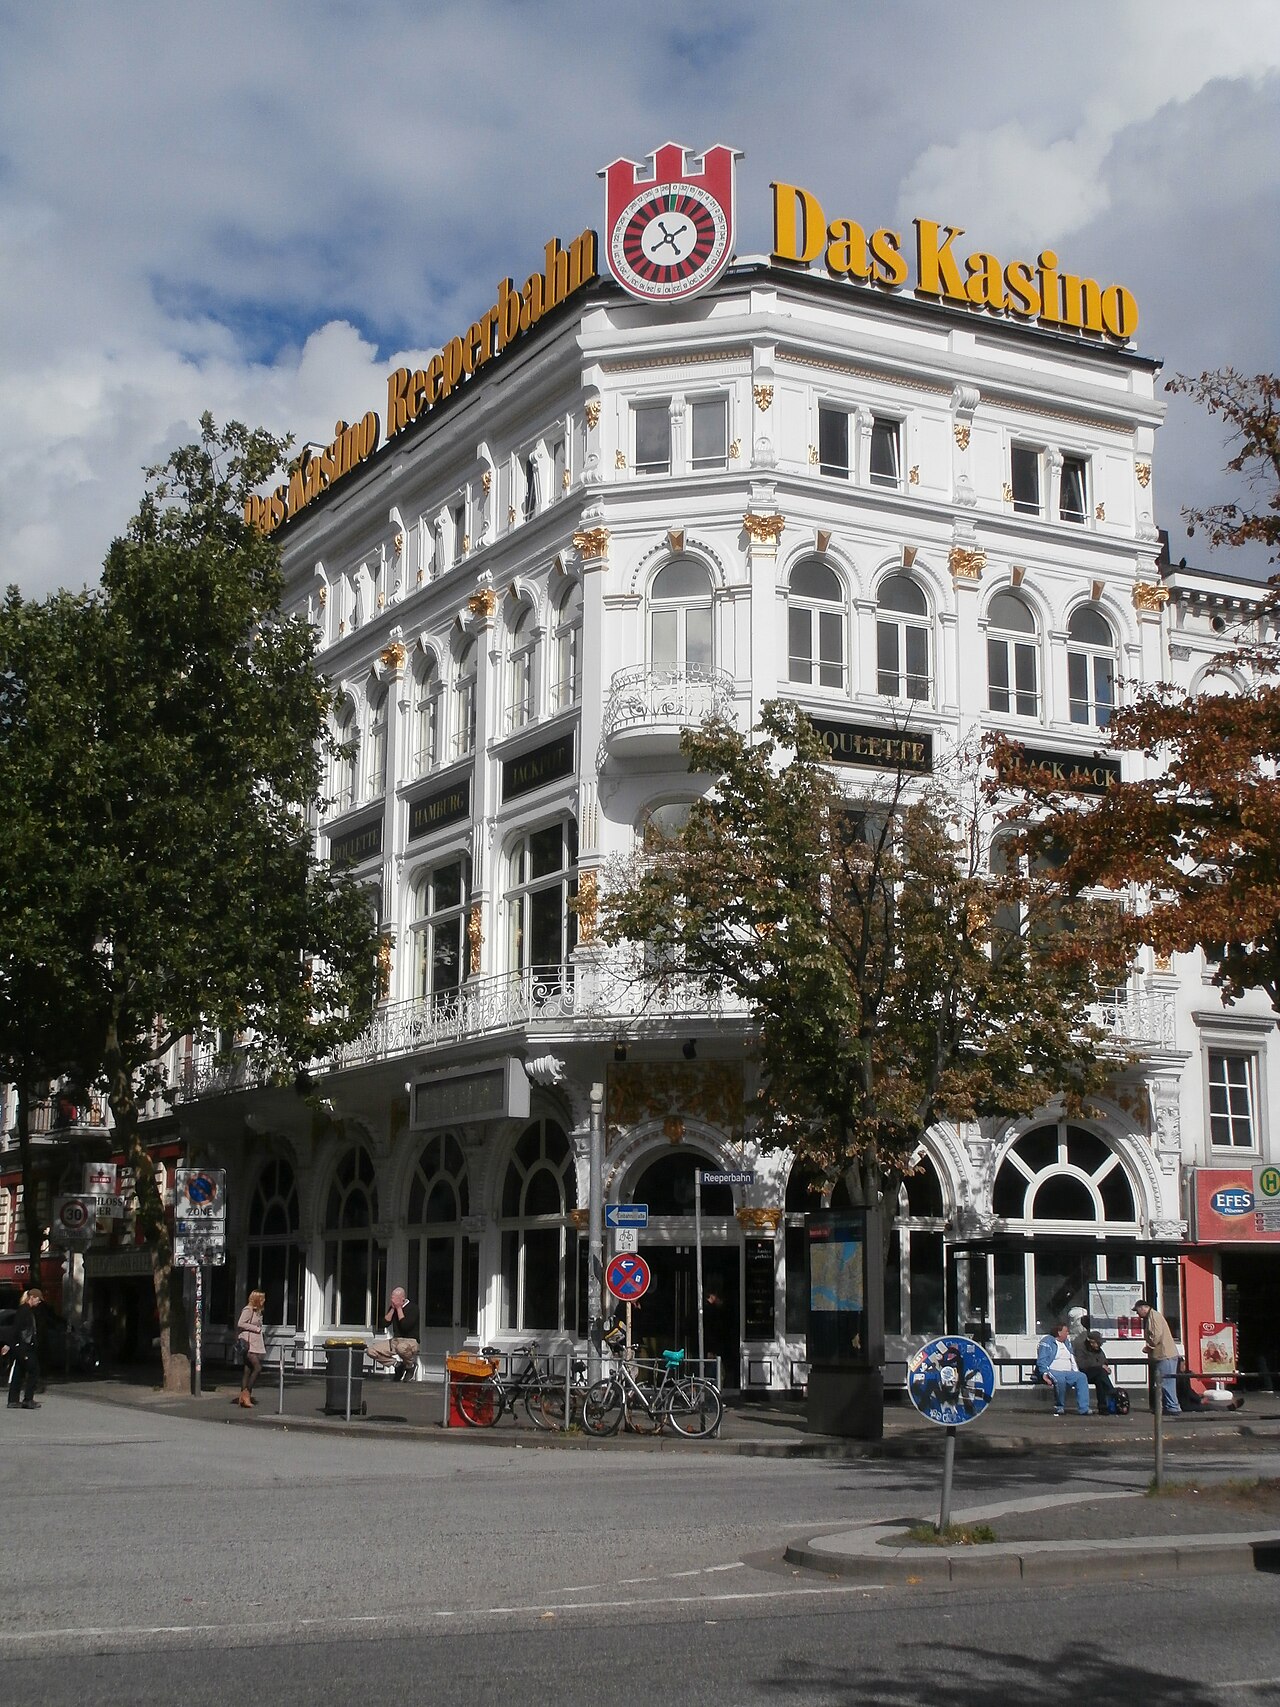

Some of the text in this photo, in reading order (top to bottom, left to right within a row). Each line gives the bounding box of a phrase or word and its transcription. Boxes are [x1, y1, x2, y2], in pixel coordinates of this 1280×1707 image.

[769, 182, 1139, 339] Das Kasino
[287, 411, 381, 519] Kasino
[386, 229, 599, 441] Reeperbahn
[1070, 765, 1117, 788] JACK
[415, 792, 463, 827] HAMBURG
[704, 1173, 751, 1184] Reeperbahn
[1266, 1174, 1277, 1190] H
[1216, 1194, 1251, 1207] EFES
[66, 1209, 82, 1220] 30
[187, 1207, 213, 1216] ZONE
